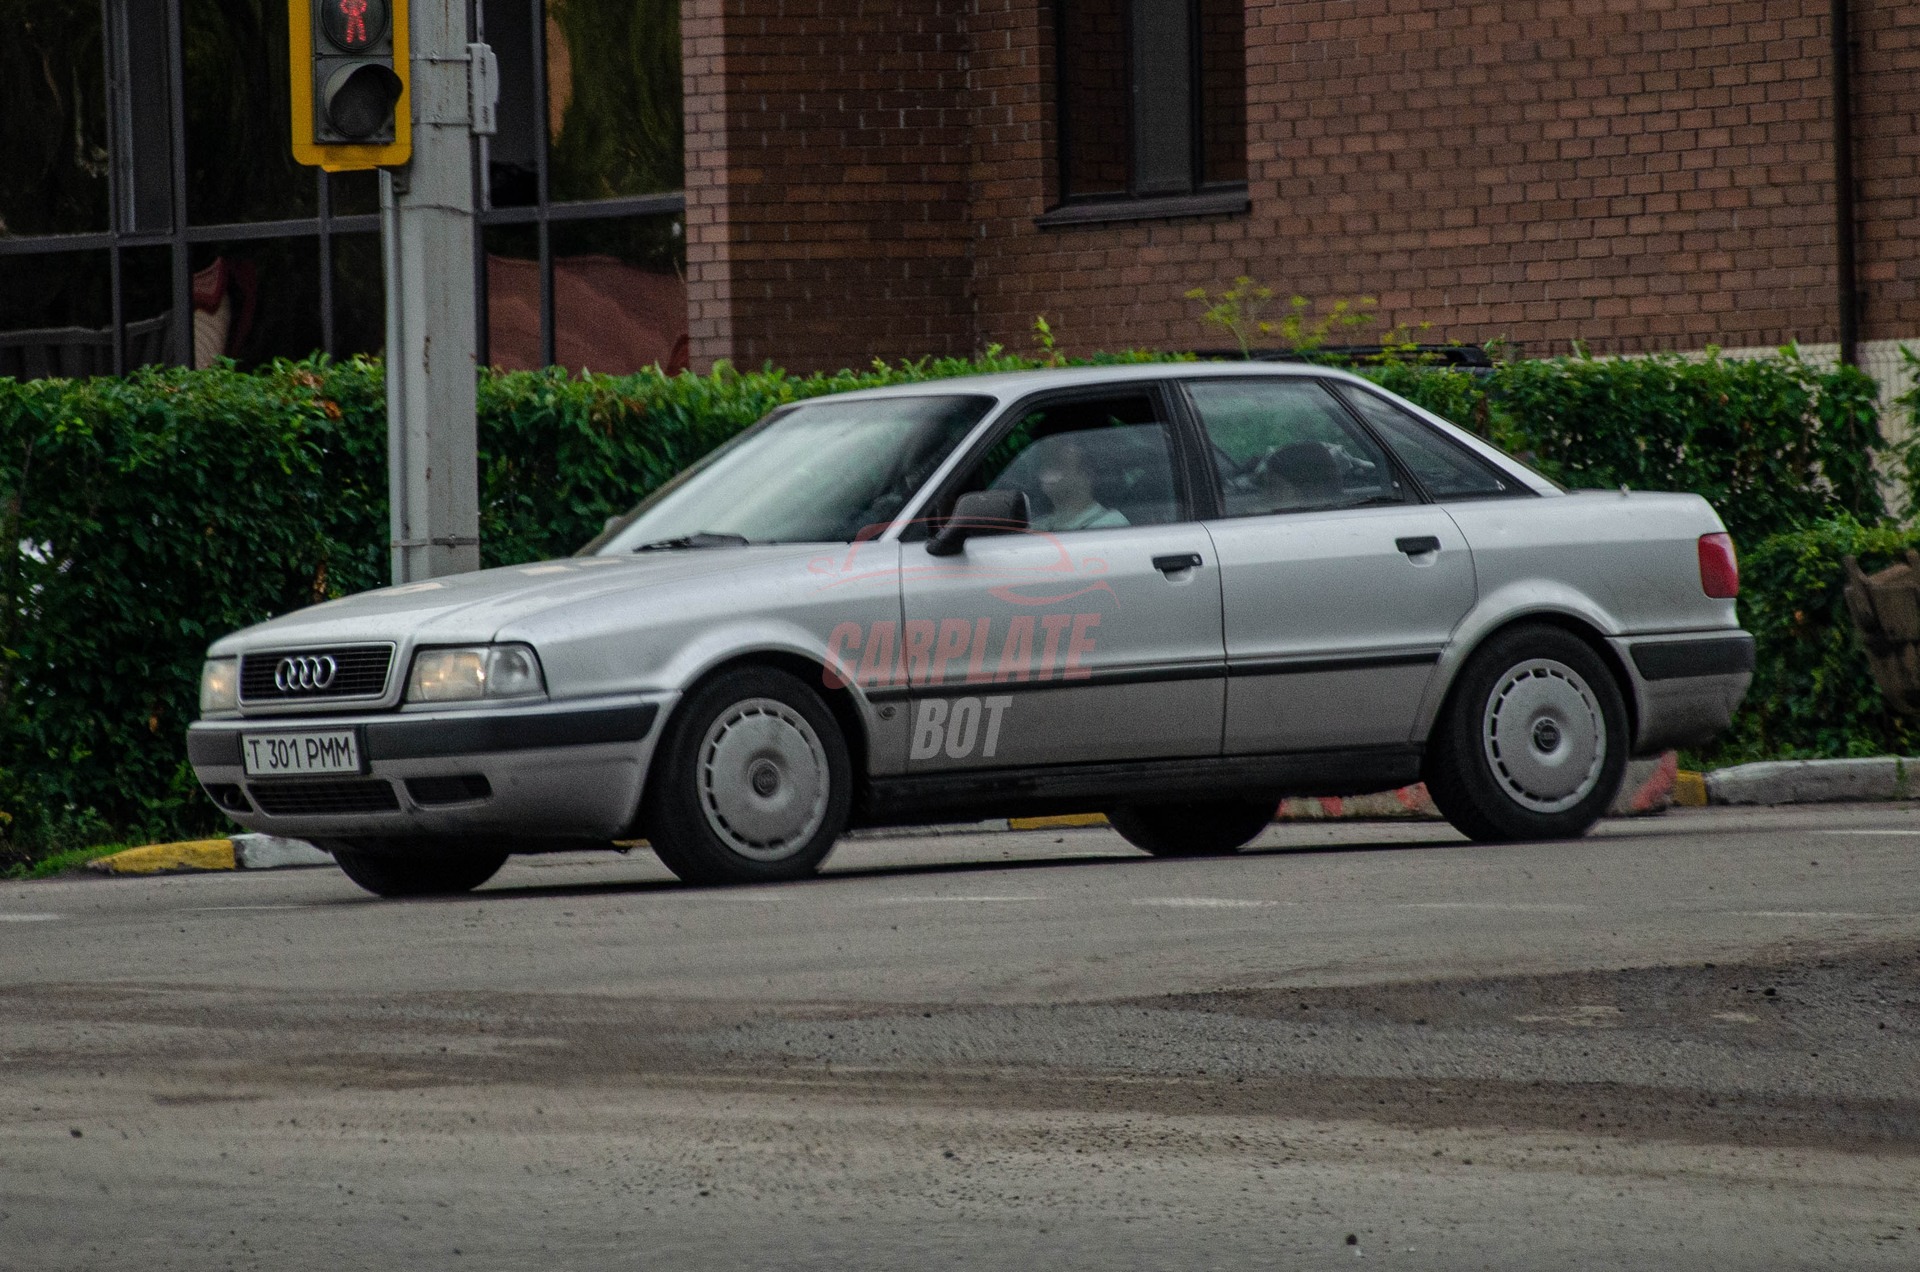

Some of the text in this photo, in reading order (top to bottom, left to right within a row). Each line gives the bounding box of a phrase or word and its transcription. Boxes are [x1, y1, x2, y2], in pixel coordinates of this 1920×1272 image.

[248, 736, 353, 769] T 301 PMM
